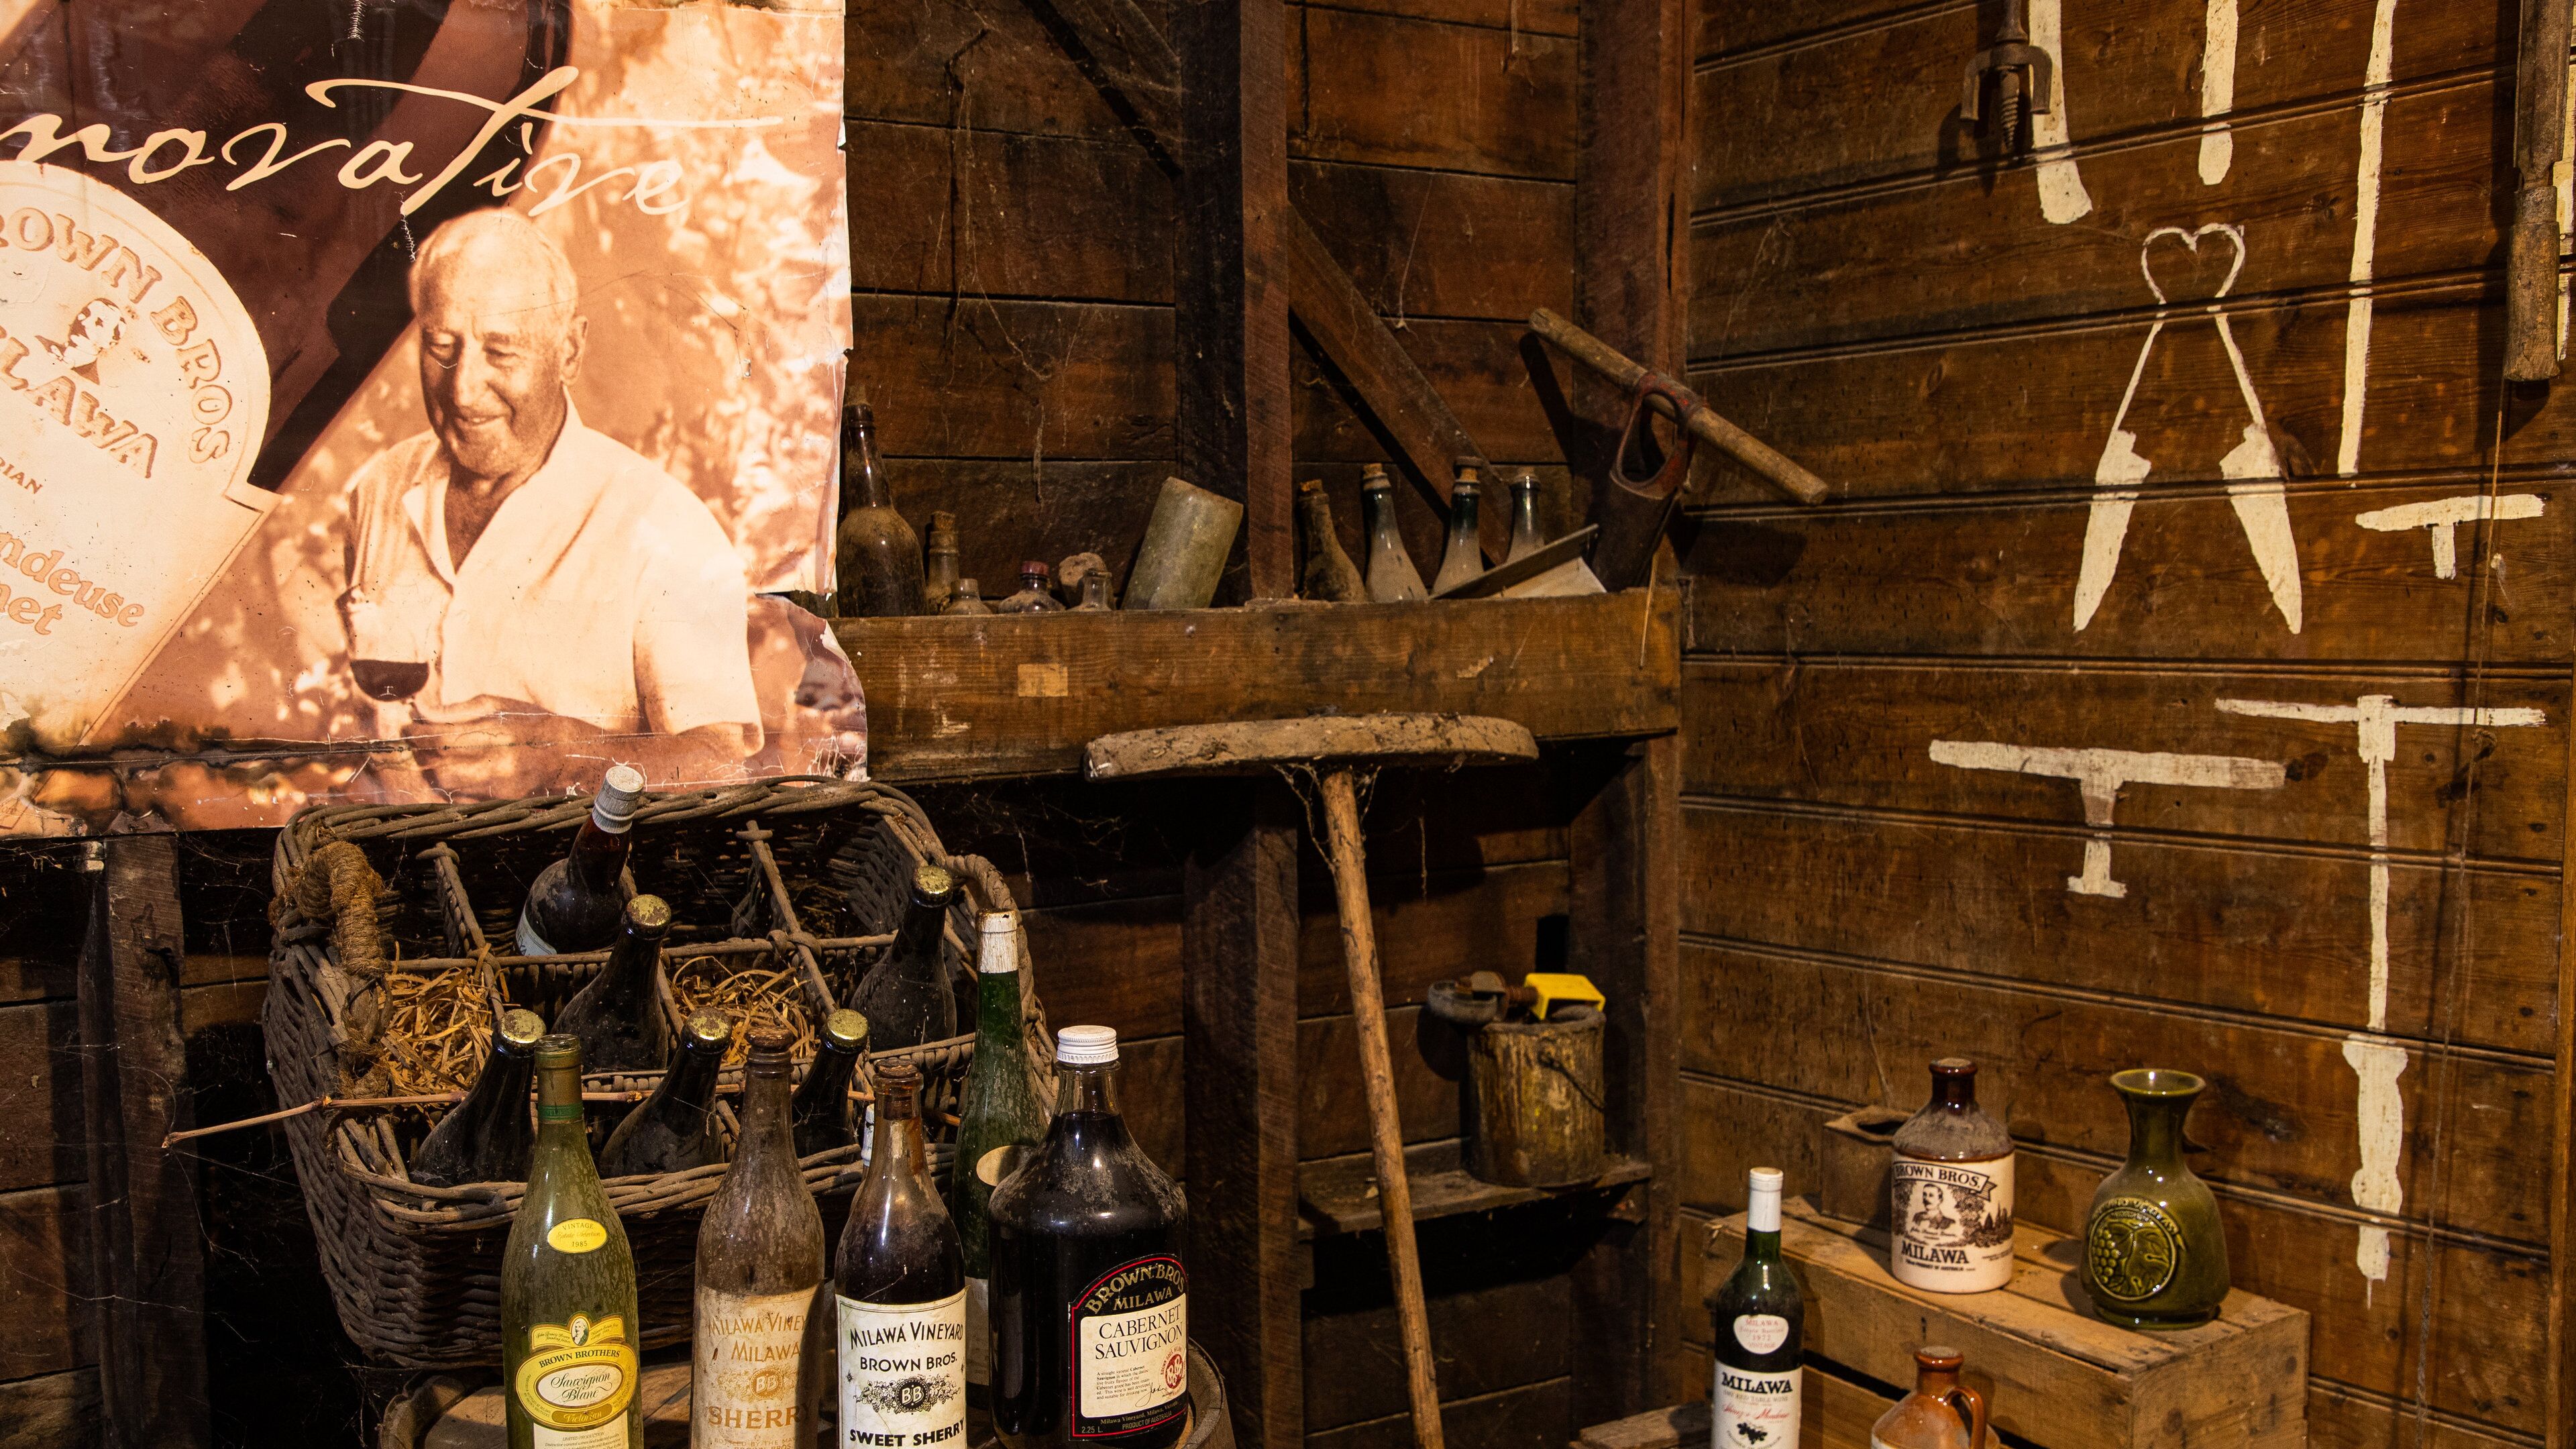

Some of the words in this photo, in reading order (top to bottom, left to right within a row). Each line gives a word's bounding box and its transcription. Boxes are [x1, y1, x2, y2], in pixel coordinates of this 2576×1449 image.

[0, 207, 162, 305] OWN
[150, 295, 233, 464] BROS
[0, 325, 158, 479] LAWA
[1938, 1169, 1980, 1188] BROS.
[1901, 1240, 1969, 1264] MILAWA
[1085, 1265, 1154, 1314] BROWN
[1155, 1264, 1185, 1293] BROS
[1113, 1286, 1173, 1311] MILAWA
[708, 1316, 763, 1337] MILAWA
[767, 1312, 810, 1332] VINEY
[1099, 1303, 1181, 1339] CABERNET
[850, 1325, 906, 1350] MILAWA
[910, 1322, 963, 1341] VINEYARD
[1095, 1321, 1183, 1360] SAUVIGNON
[539, 1353, 572, 1368] BROWN
[575, 1350, 621, 1358] BROTHERS
[731, 1340, 802, 1362] MILAWA
[860, 1356, 921, 1373] BROWN
[926, 1352, 957, 1370] BROS.
[551, 1373, 610, 1390] Sauvignon
[756, 1373, 777, 1392] BB
[1722, 1371, 1793, 1394] MILAWA
[561, 1383, 612, 1403] Blanc
[902, 1386, 924, 1405] BB
[564, 1411, 602, 1423] Victorian
[1122, 1413, 1146, 1422] Vineyard,
[1122, 1420, 1144, 1430] PRODUCT
[1150, 1411, 1173, 1424] AUSTRALIA
[850, 1429, 906, 1447] SWEET
[913, 1417, 964, 1446] SHERRY
